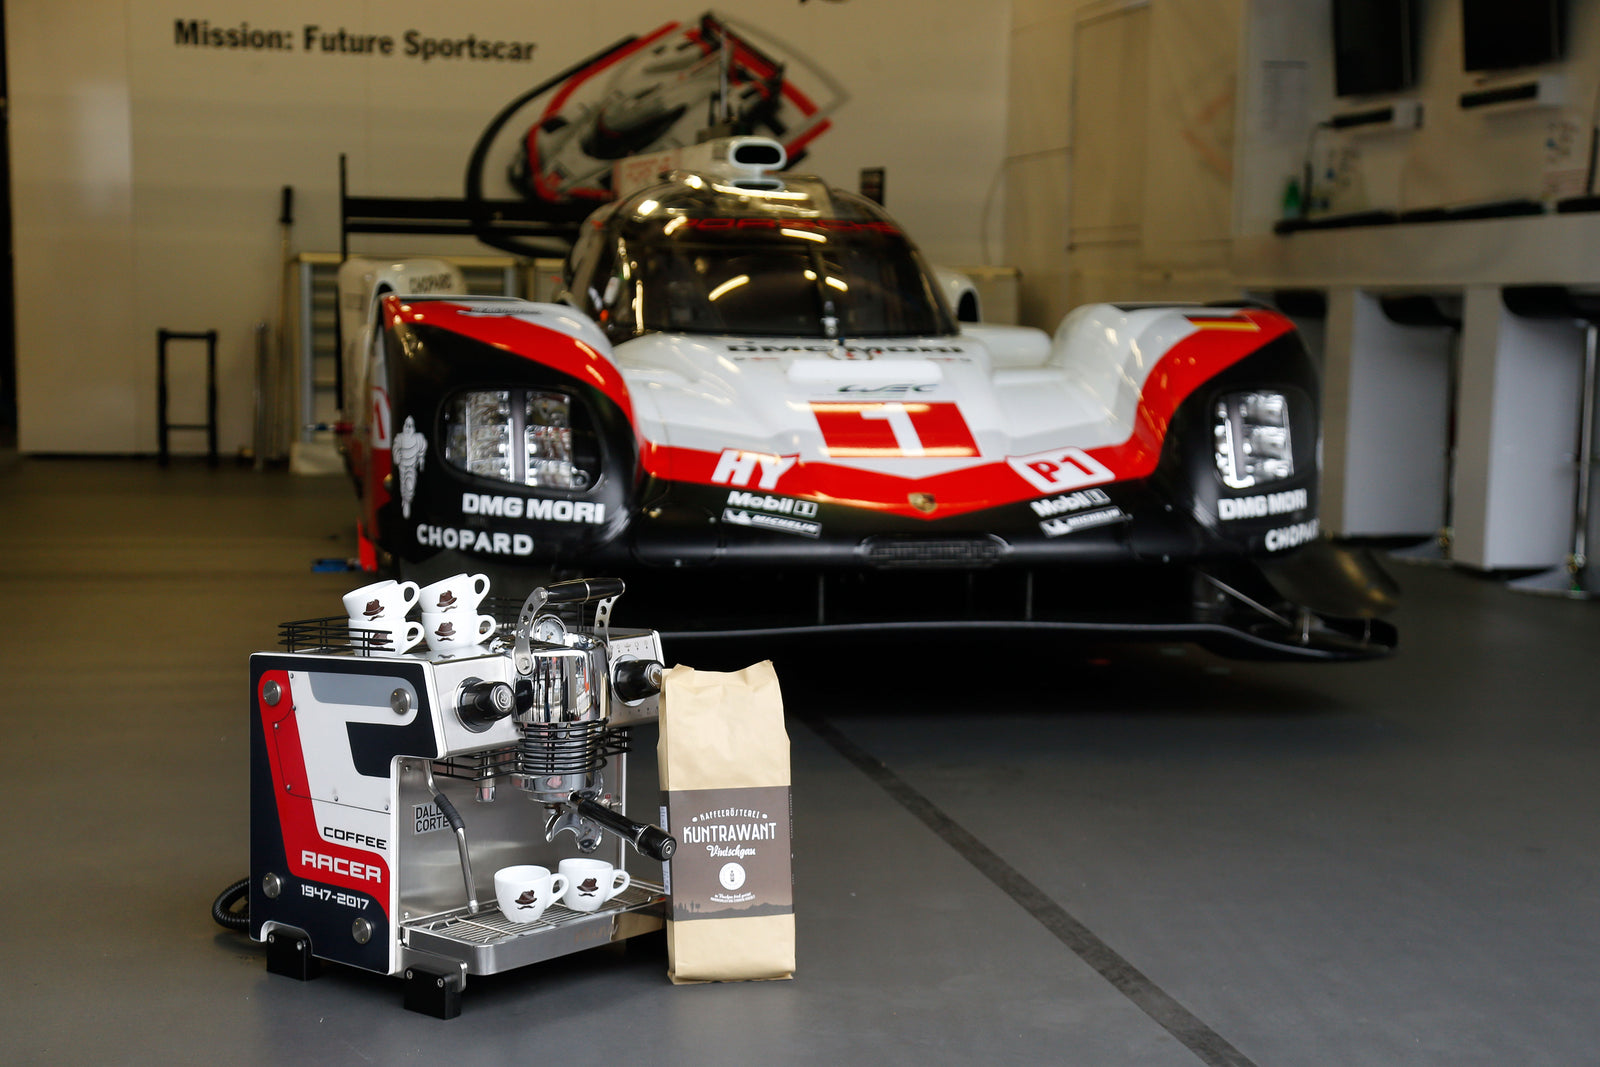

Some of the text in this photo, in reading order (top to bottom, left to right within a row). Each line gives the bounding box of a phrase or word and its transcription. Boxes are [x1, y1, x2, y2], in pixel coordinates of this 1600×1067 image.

[174, 19, 537, 63] Mission: Future Sportscar
[711, 449, 798, 490] HY
[1026, 456, 1096, 483] P1
[462, 493, 606, 524] DMG MORI
[727, 490, 795, 514] Mobil
[1029, 491, 1092, 517] Mobil
[1218, 488, 1308, 520] DMG MORI
[416, 523, 535, 556] CHOPARD
[415, 805, 443, 820] DALL
[415, 816, 450, 833] CORTE
[699, 807, 761, 821] KAFFEERÖSTEREI
[323, 826, 388, 851] COFFEE
[683, 822, 777, 844] KUNTRAWANT
[301, 849, 382, 884] RACER
[300, 883, 370, 911] 1947-2017
